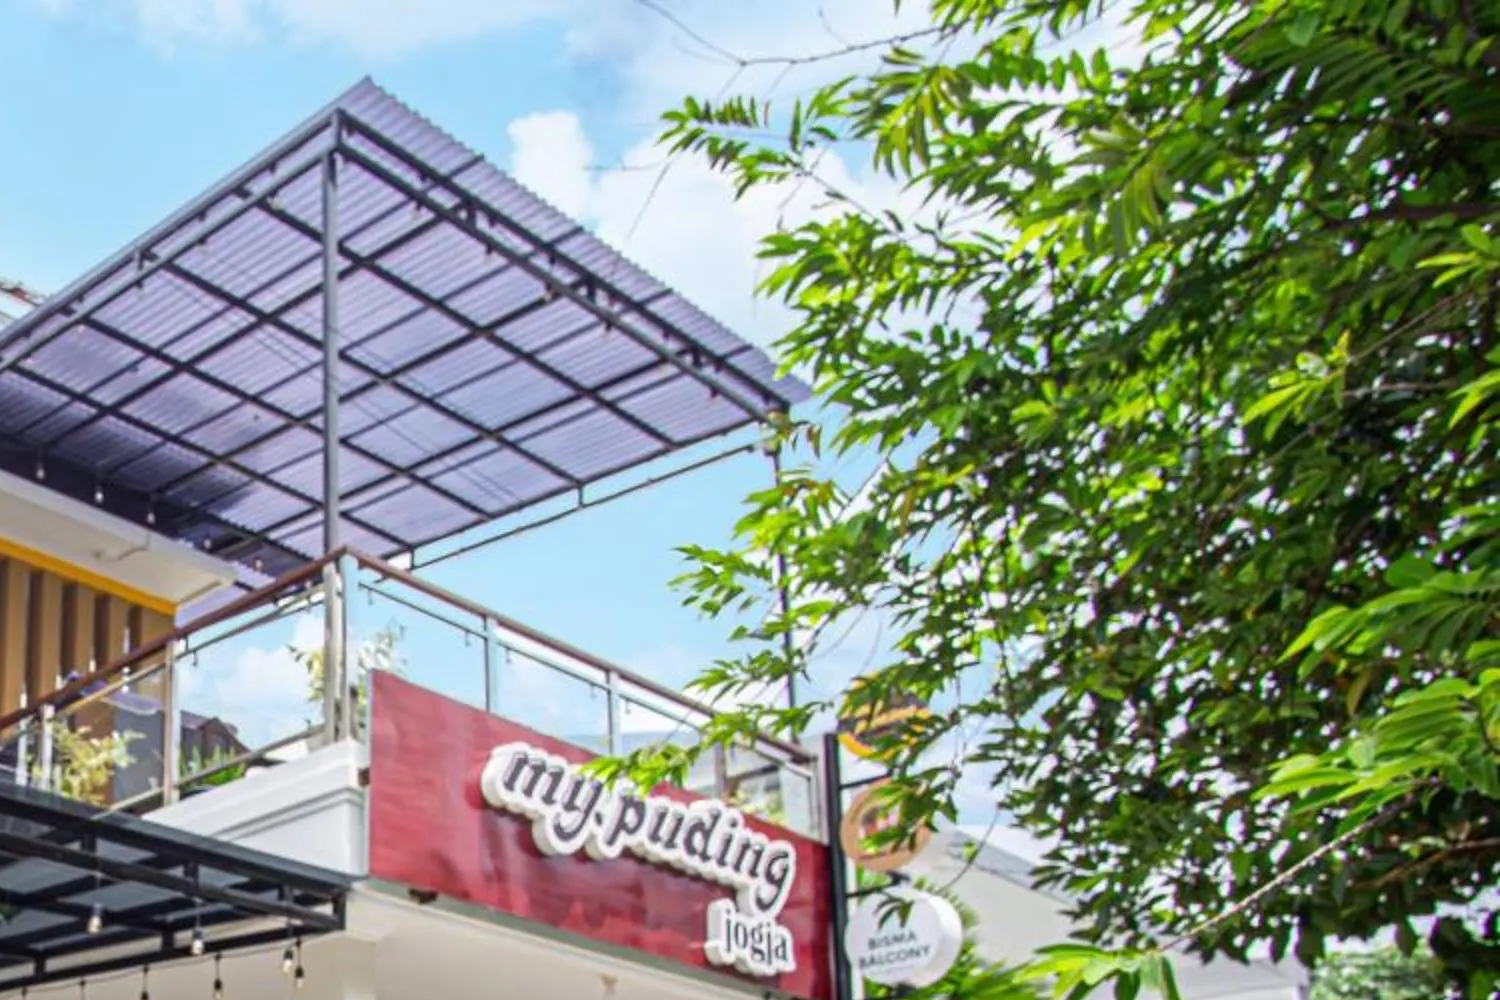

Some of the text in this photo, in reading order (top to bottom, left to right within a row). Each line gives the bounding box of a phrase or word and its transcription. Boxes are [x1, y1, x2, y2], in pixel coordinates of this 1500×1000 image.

[724, 908, 789, 966] jogja
[867, 930, 918, 951] BISMA
[858, 945, 931, 970] BALCONY
